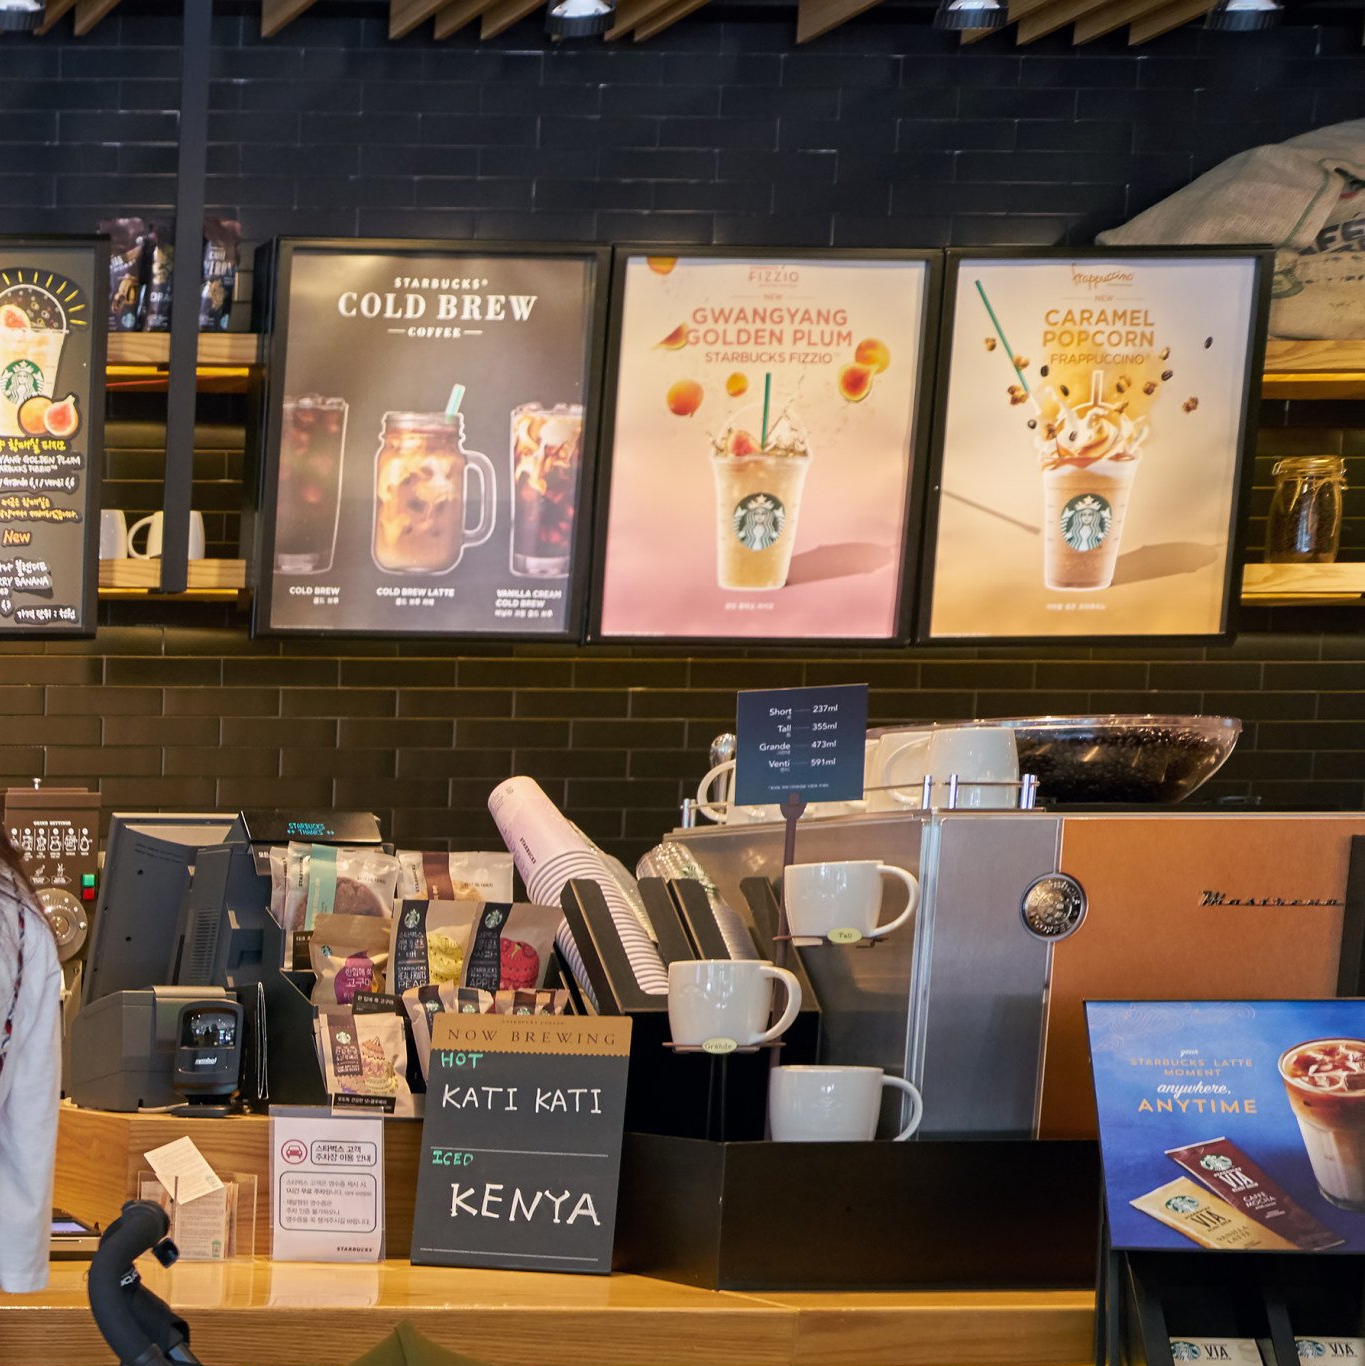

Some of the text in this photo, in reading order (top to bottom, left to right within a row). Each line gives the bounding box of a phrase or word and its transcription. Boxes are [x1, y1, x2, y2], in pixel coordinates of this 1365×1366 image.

[748, 270, 799, 283] FIZZIO
[338, 293, 538, 322] COLD BREW
[692, 307, 847, 326] GWANGYANG
[1044, 309, 1155, 327] CARAMEL
[408, 326, 461, 338] COFFEE
[685, 328, 853, 347] GOLDEN PLUM
[1042, 331, 1155, 348] POPCORN
[705, 352, 786, 363] STARBUCKS
[23, 455, 55, 465] GOLDEN
[57, 455, 80, 465] PLUM
[4, 529, 30, 544] New
[15, 576, 49, 586] BANANA
[290, 587, 340, 595] COLD BREW
[376, 587, 455, 597] COLD BREW LATTE
[496, 589, 561, 599] VANILLA CREAM
[496, 599, 545, 608] COLD BREW
[769, 704, 838, 716] Short 237ml
[778, 722, 837, 733] Tall 355ml
[759, 740, 836, 751] Grande 473ml
[769, 758, 835, 768] Venti 591ml
[288, 822, 326, 830] STARBUCKS
[519, 837, 537, 864] STARBUCKS
[448, 1029, 615, 1045] NOW BREWING
[705, 1042, 732, 1050] Grande
[1180, 1049, 1199, 1057] your
[441, 1052, 483, 1068] HOT
[1214, 1059, 1252, 1067] LATTE
[1164, 1069, 1221, 1077] MOMENT
[1157, 1081, 1231, 1099] anywhere,
[443, 1084, 601, 1113] KATI KATI
[1138, 1099, 1257, 1114] ANYTIME
[316, 1154, 337, 1162] 주차장
[432, 1150, 474, 1166] ICED
[1219, 1171, 1254, 1188] VIA
[451, 1183, 600, 1225] KENYA
[1192, 1210, 1226, 1228] VIA
[1204, 1344, 1229, 1357] VIA
[1329, 1343, 1355, 1355] VIA
